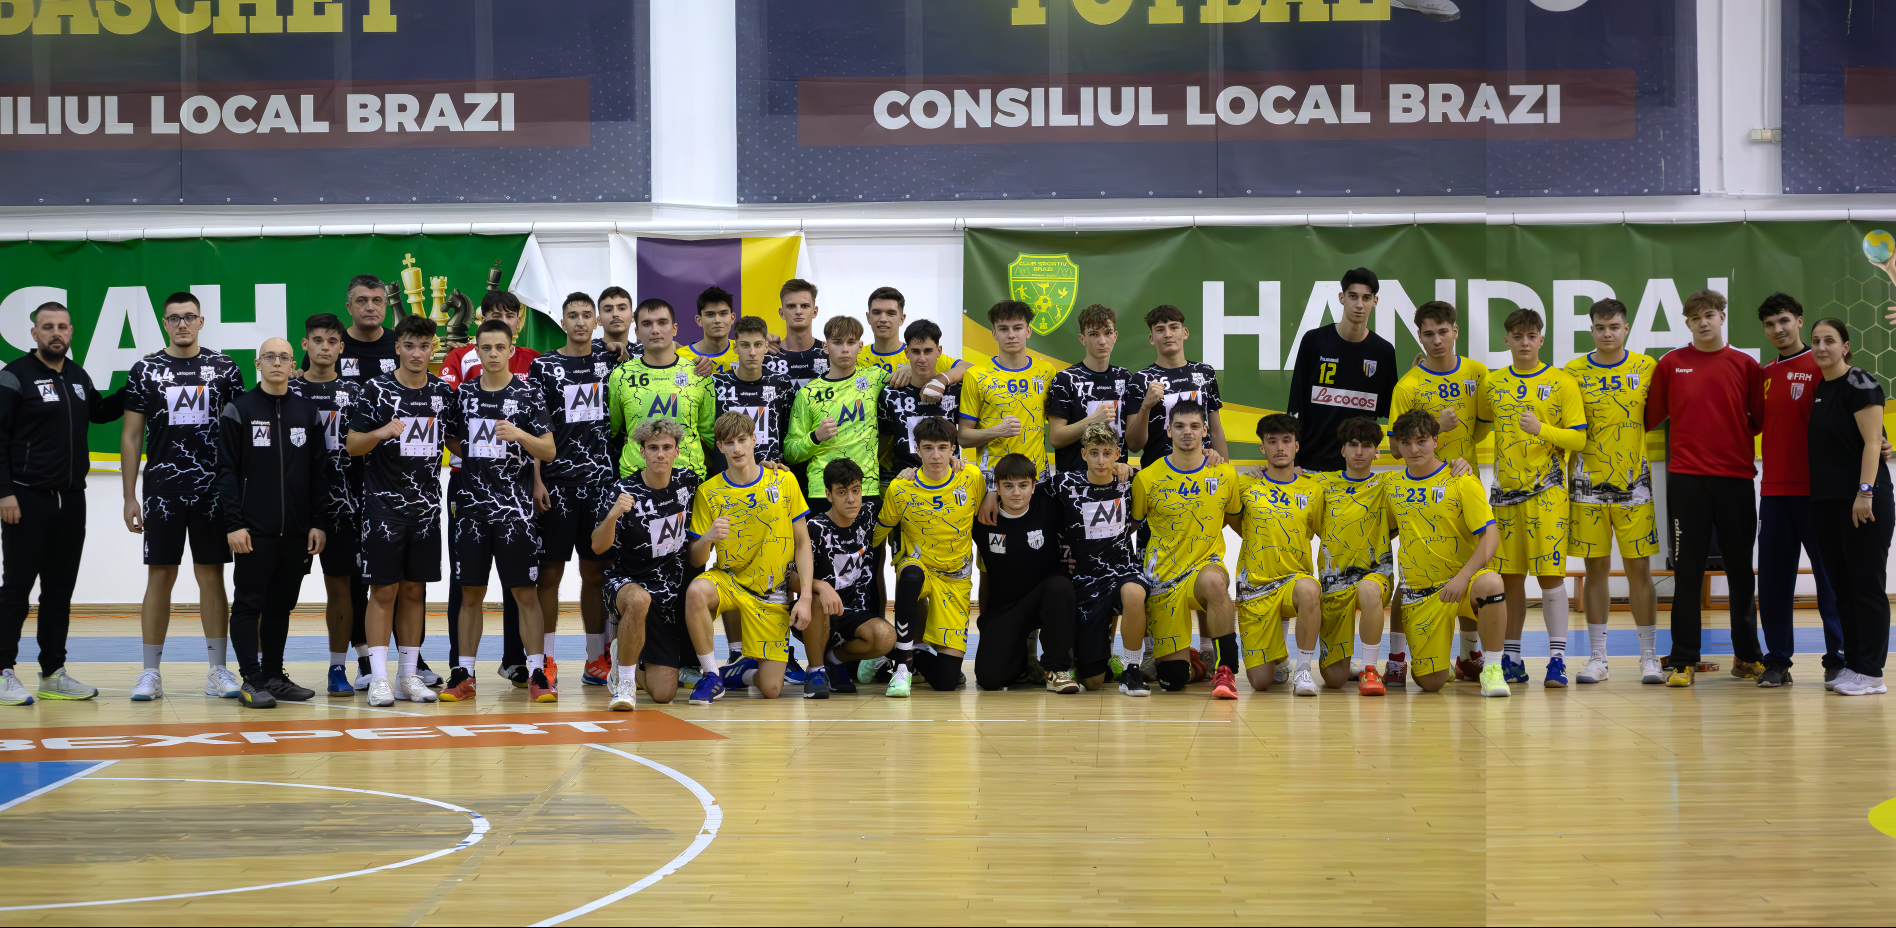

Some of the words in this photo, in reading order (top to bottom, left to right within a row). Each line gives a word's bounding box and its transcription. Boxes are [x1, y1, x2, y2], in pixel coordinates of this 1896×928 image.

[150, 94, 329, 134] LOCAL
[347, 92, 515, 132] BRAZI
[873, 86, 1168, 130] CONSILIUL
[1187, 84, 1371, 126] LOCAL
[1389, 83, 1561, 124] BRAZI
[554, 367, 565, 381] 9
[766, 360, 789, 374] 28
[1319, 362, 1337, 384] 12
[151, 367, 175, 383] 44
[628, 373, 650, 388] 16
[1007, 379, 1029, 394] 69
[1075, 382, 1094, 397] 77
[1437, 382, 1460, 399] 88
[1598, 376, 1621, 390] 15
[717, 386, 738, 401] 21
[815, 387, 835, 404] 16
[1312, 387, 1333, 403] La
[1517, 385, 1527, 399] 9
[391, 396, 401, 412] 7
[462, 398, 479, 414] 13
[894, 397, 915, 413] 18
[1068, 486, 1089, 498] 17
[1178, 481, 1200, 496] 44
[1406, 488, 1426, 502] 23
[746, 493, 757, 508] 3
[933, 495, 943, 510] 5
[1268, 489, 1290, 506] 34
[634, 499, 657, 517] 11
[1552, 550, 1560, 566] 9
